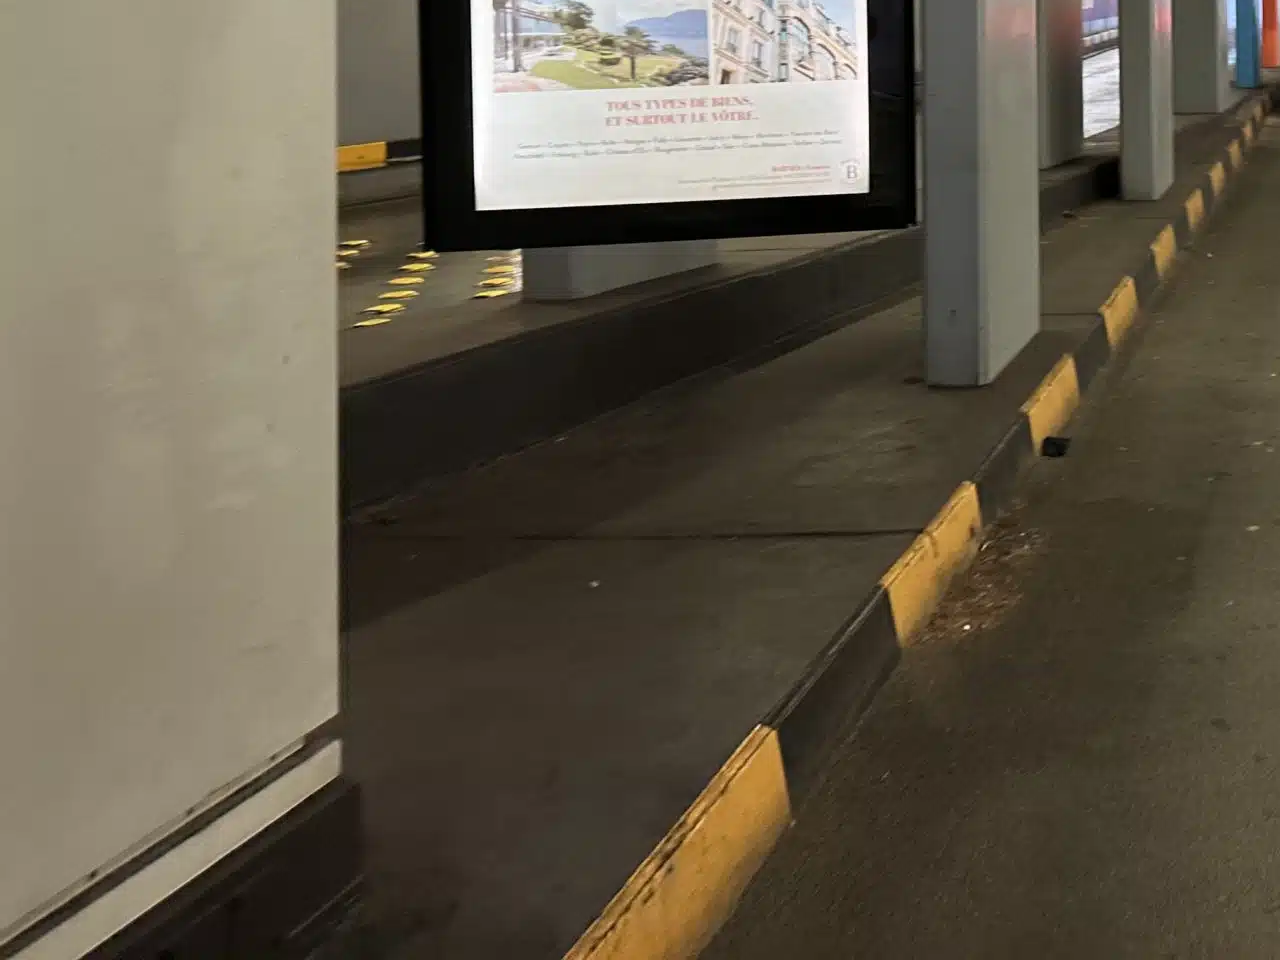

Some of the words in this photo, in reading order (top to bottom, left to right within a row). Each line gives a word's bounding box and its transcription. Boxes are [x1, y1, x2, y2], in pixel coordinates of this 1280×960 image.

[606, 100, 641, 112] TOUS
[645, 98, 688, 110] TYPES
[690, 97, 709, 108] DE
[604, 115, 622, 127] ET
[625, 113, 689, 126] SURTOUT
[691, 111, 709, 123] LE
